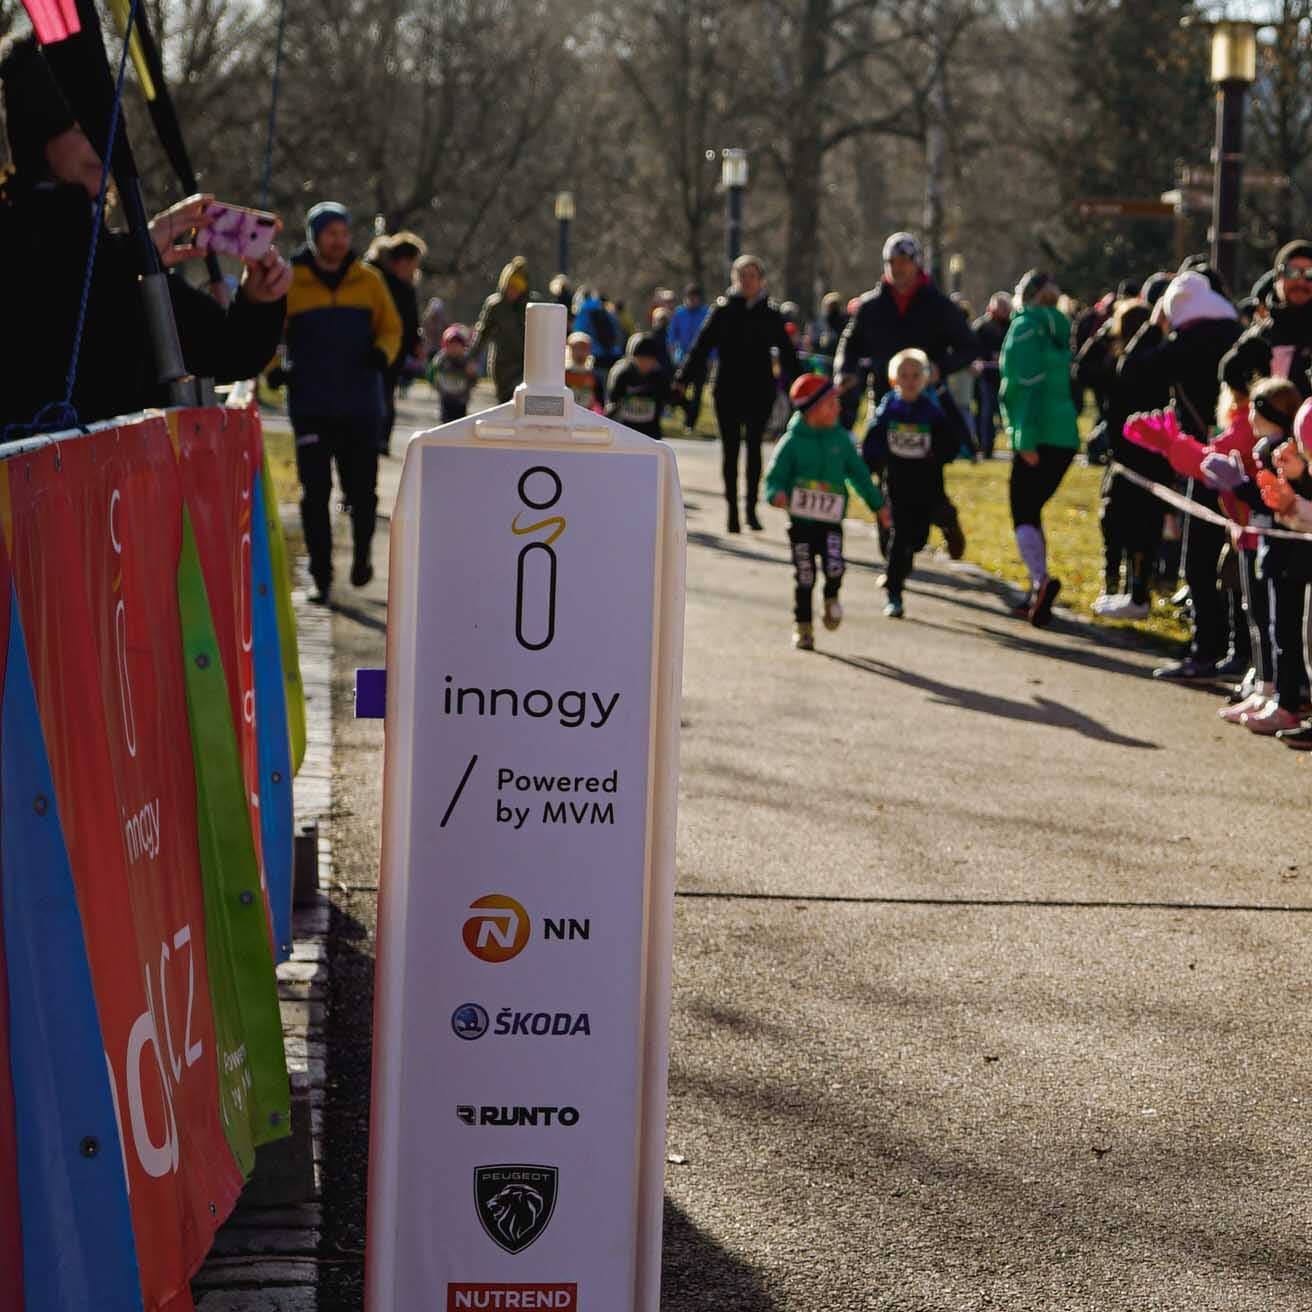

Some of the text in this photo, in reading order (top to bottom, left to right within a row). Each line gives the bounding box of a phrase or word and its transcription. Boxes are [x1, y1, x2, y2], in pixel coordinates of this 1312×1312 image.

[444, 675, 620, 728] innogy
[498, 768, 618, 793] Powered
[496, 799, 614, 829] by MVM
[544, 918, 590, 940] NN
[493, 1008, 591, 1037] ŠKODA
[482, 1172, 550, 1182] PEUGEOT
[455, 1290, 571, 1309] NUTREND
